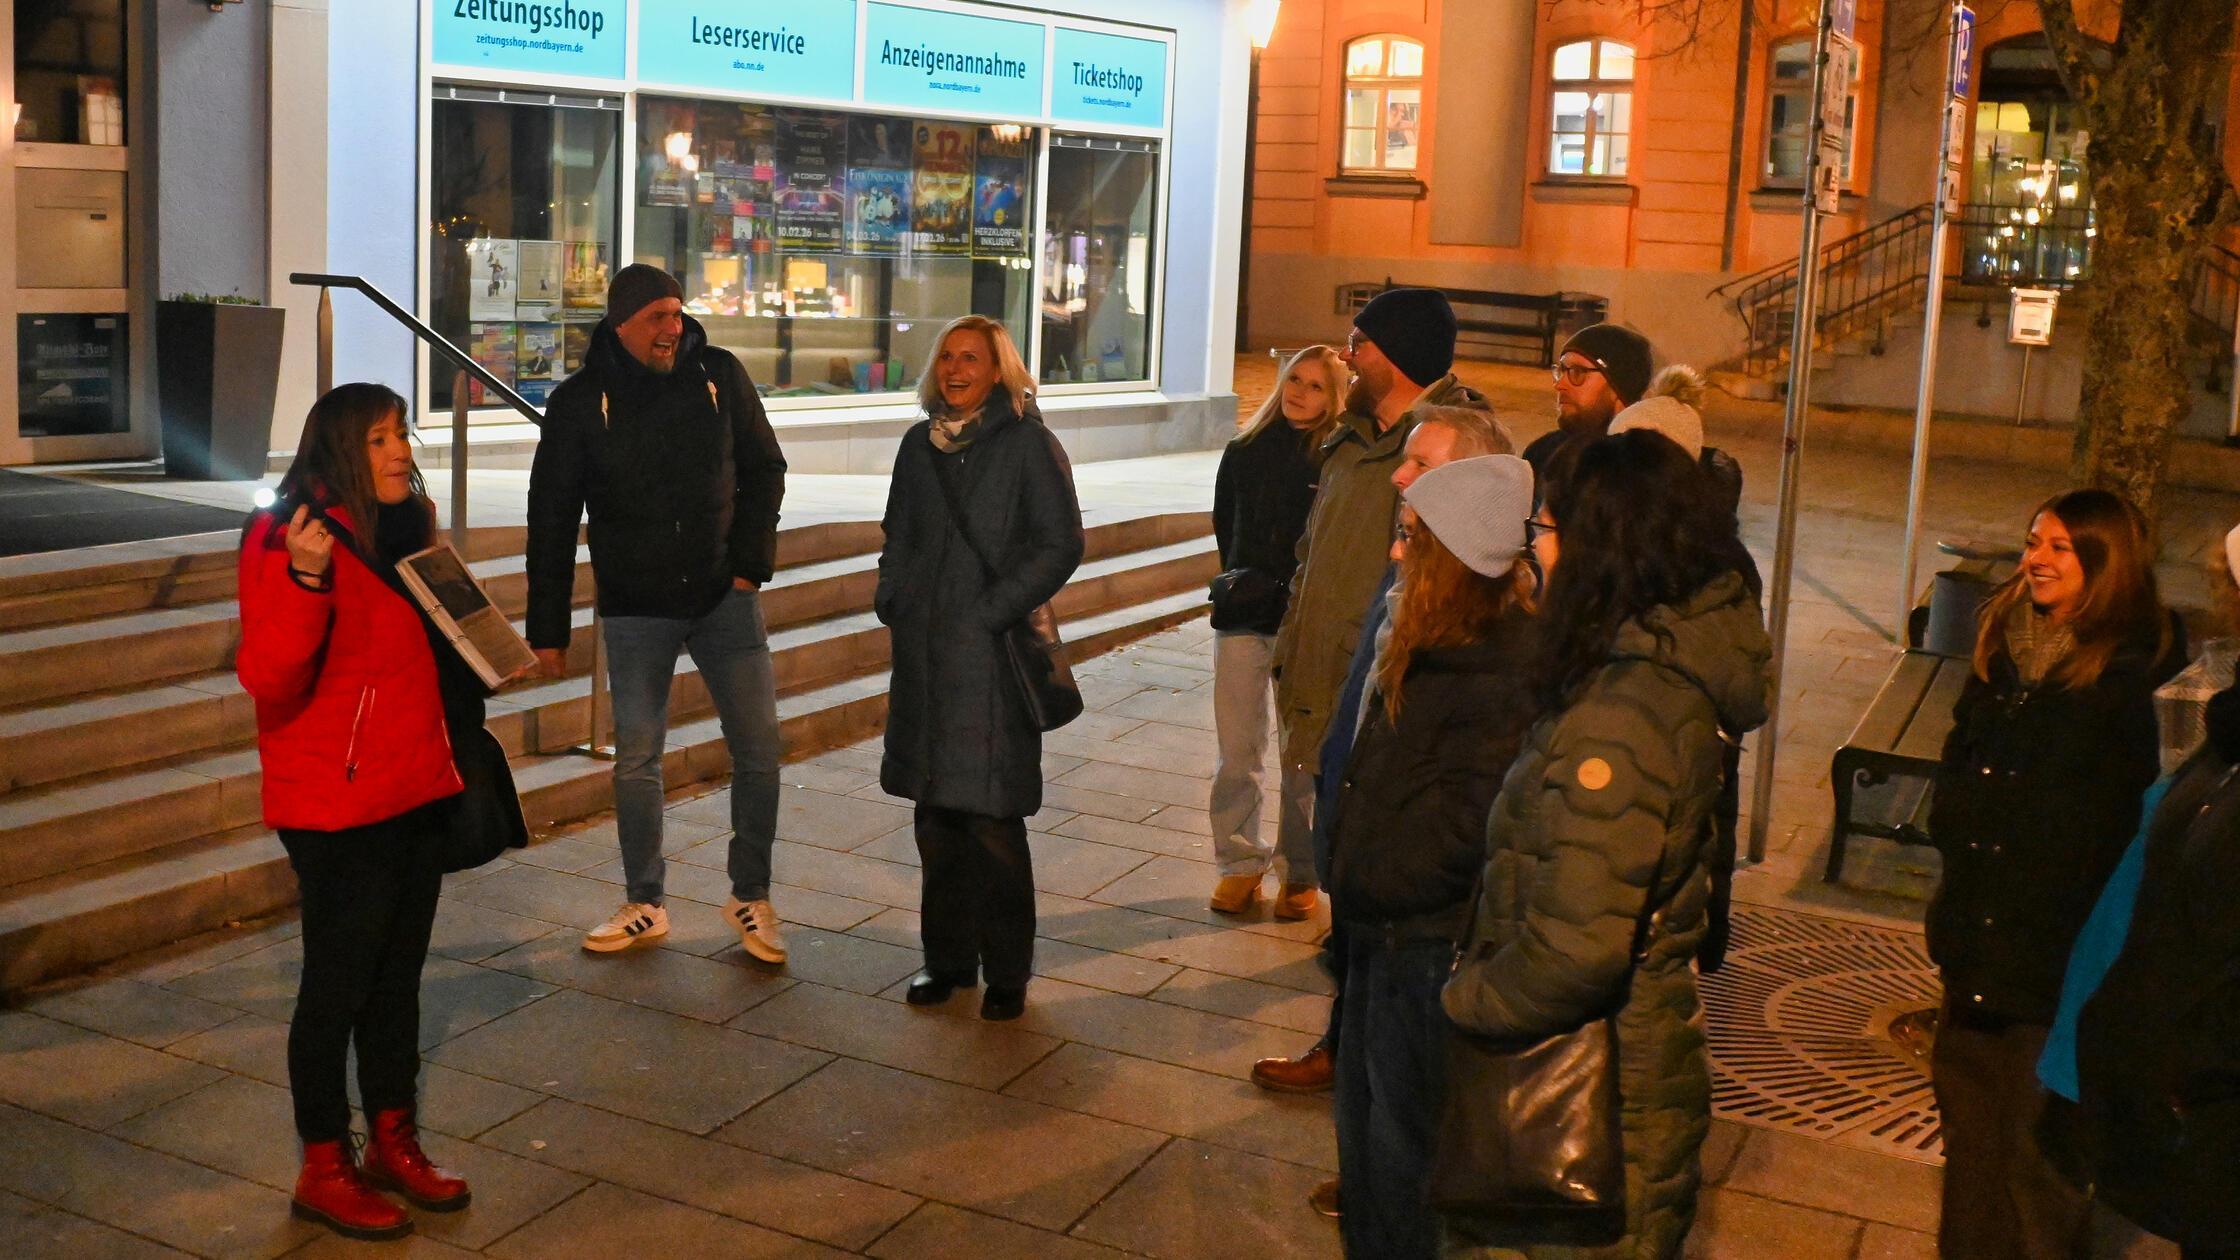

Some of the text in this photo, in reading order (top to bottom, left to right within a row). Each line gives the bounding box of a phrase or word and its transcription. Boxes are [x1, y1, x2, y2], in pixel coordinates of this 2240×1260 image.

[453, 0, 605, 39] Zeitungsshop
[476, 34, 584, 54] zeitungsshop.nordbayern.de
[691, 16, 805, 55] Leserservice
[733, 59, 765, 72] abo.nn.de
[881, 39, 1026, 79] Anzeigenannahme
[1073, 62, 1143, 98] Ticketshop
[974, 227, 1022, 238] HERZKLOPFEN
[981, 237, 1015, 247] INKLUSIVE
